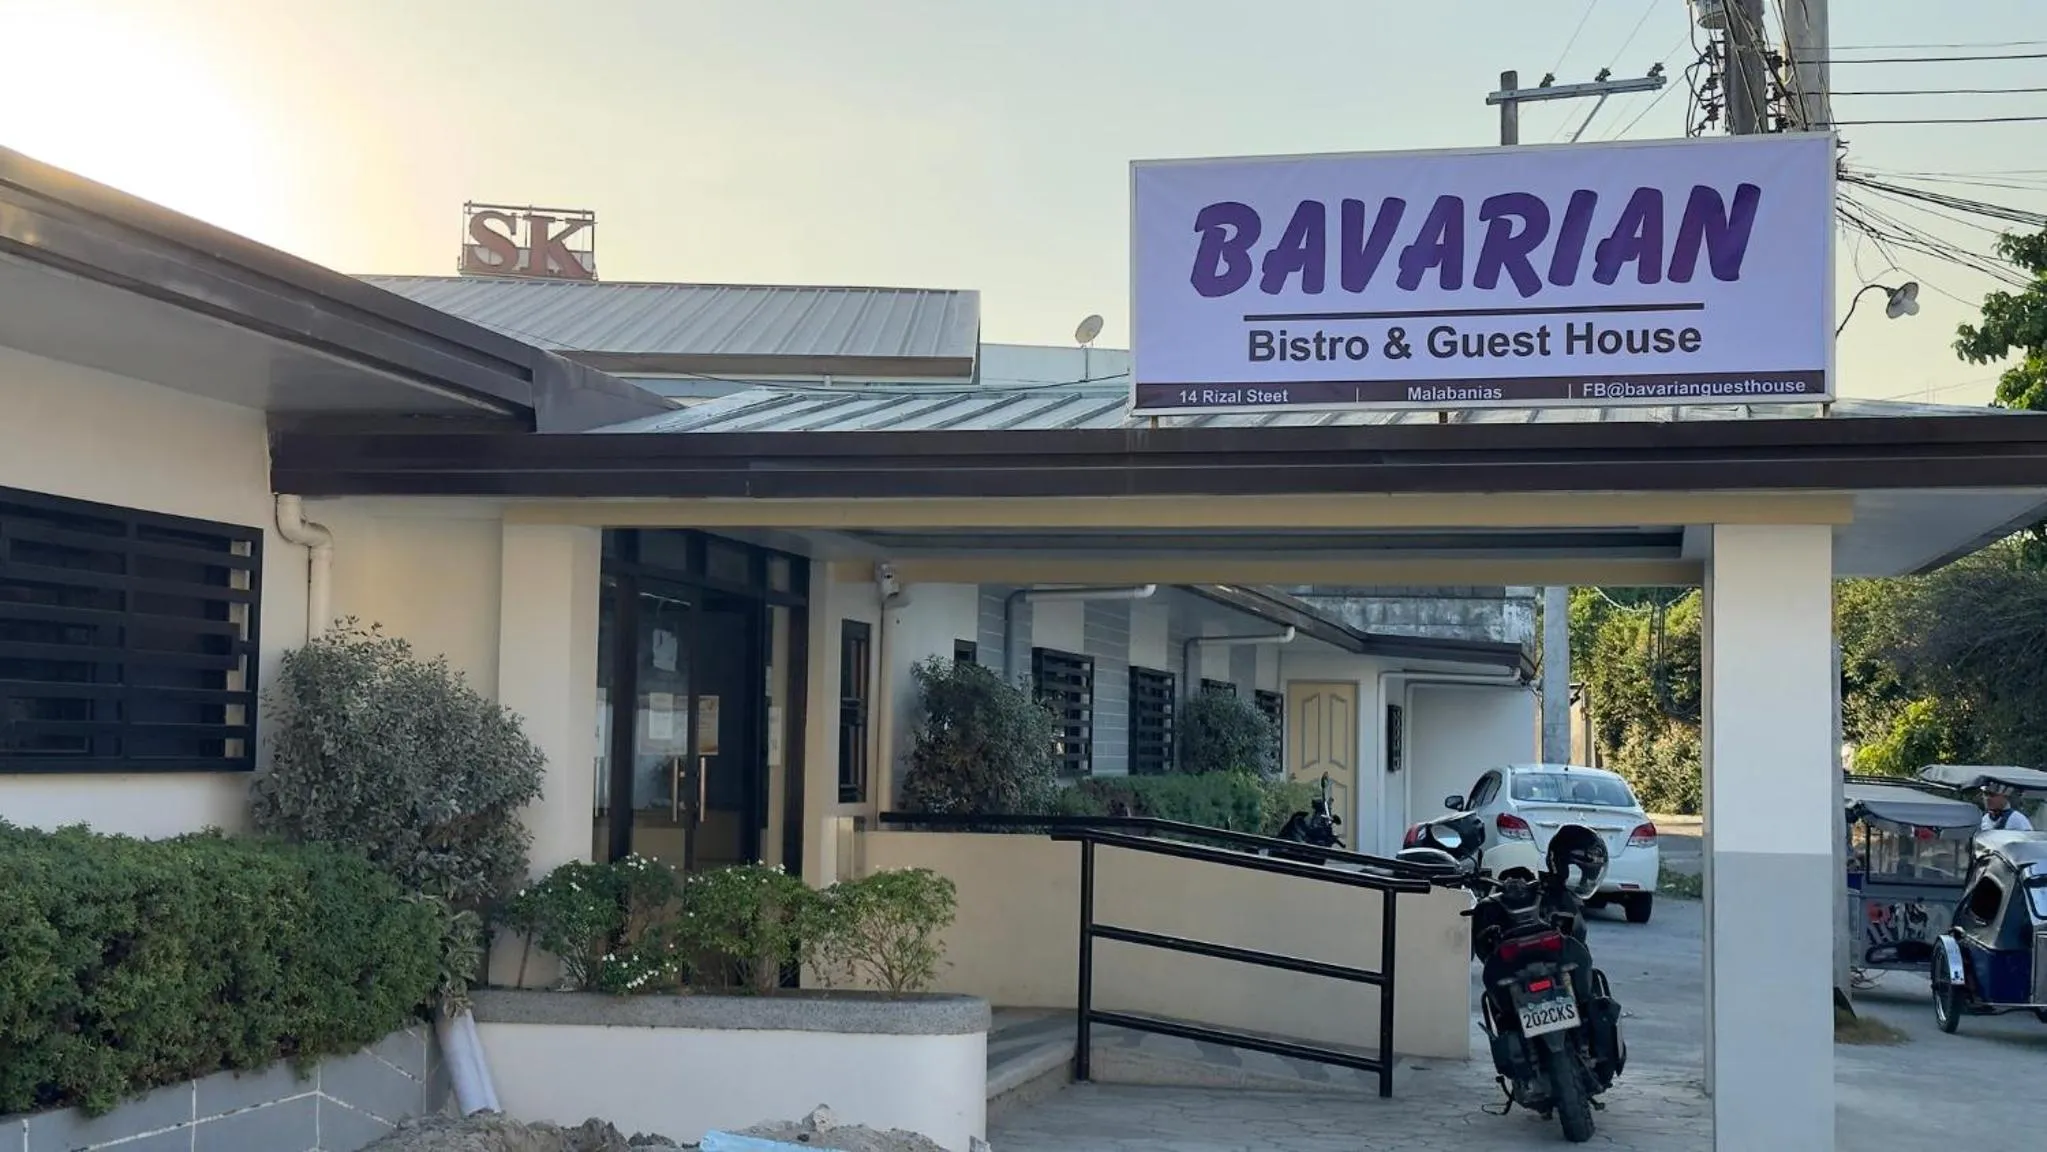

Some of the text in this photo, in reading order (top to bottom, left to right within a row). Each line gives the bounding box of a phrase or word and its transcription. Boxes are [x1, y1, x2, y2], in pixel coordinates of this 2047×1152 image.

[469, 210, 595, 279] SK
[1189, 182, 1761, 298] BAVARIAN
[1248, 322, 1702, 362] Bistro & Guest House
[1179, 388, 1289, 403] 14 Rizal Steet
[1407, 386, 1503, 401] Malabanias
[1582, 378, 1807, 398] FB@bavarianguesthouse
[1523, 1003, 1576, 1029] 202CKS
